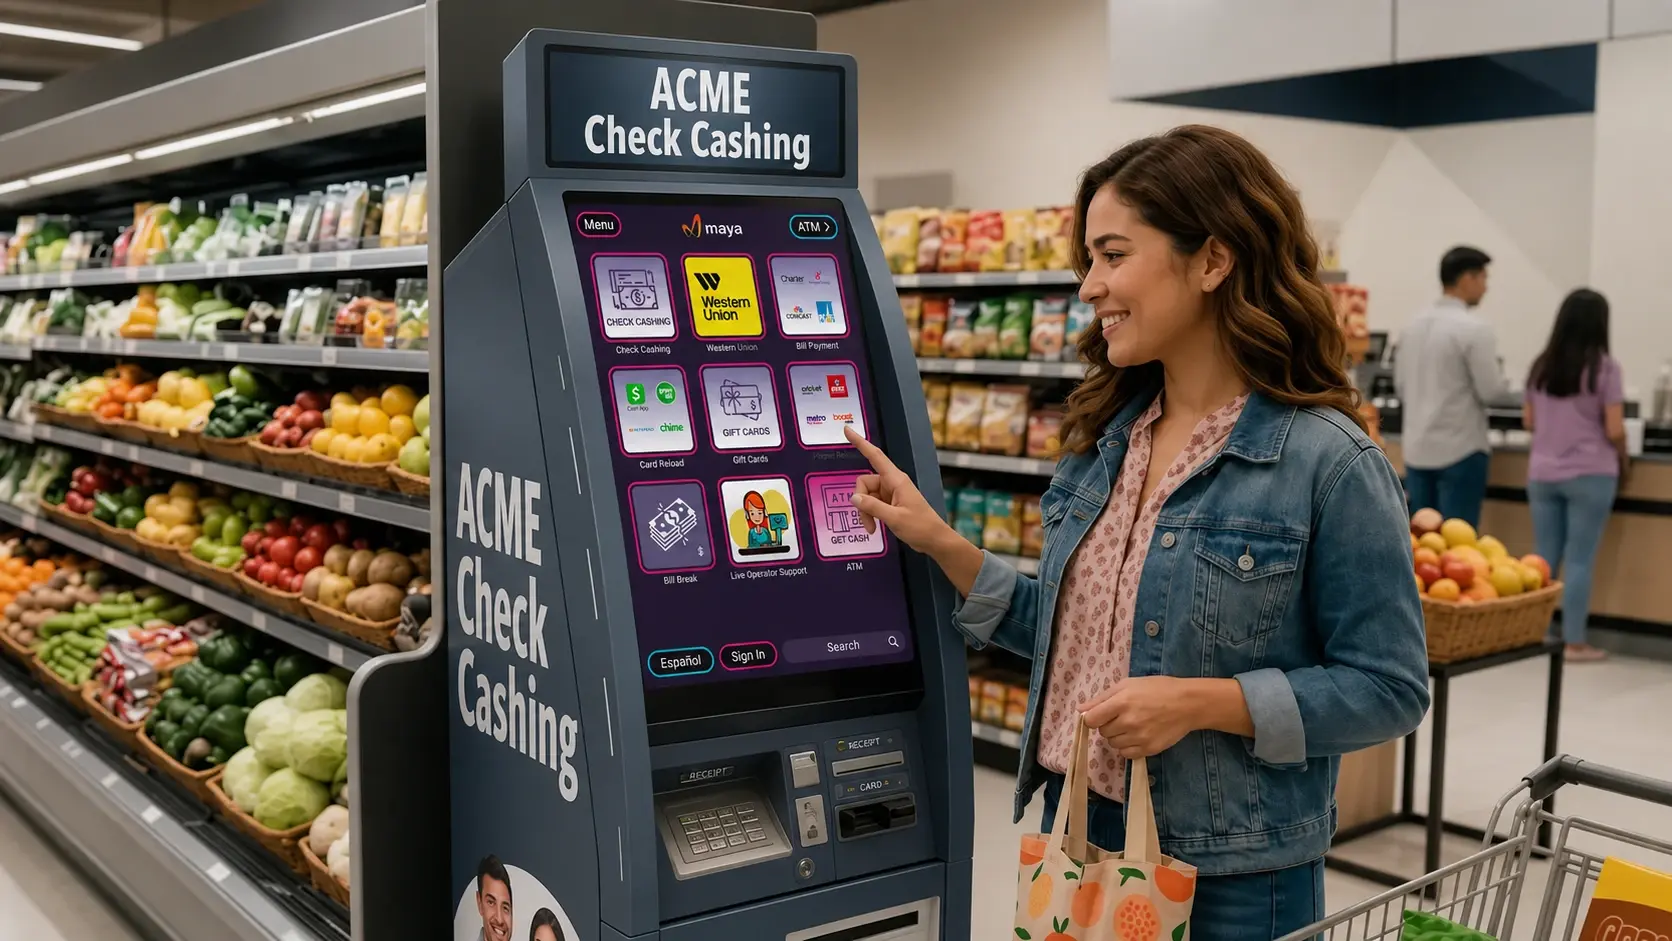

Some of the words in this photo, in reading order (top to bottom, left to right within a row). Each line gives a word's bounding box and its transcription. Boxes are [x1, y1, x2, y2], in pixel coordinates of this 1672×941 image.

[650, 66, 751, 114] ACME
[584, 114, 682, 157] Check
[690, 120, 811, 170] Cashing
[584, 218, 614, 230] Menu
[798, 222, 820, 232] ATM
[705, 224, 743, 238] maya
[701, 296, 751, 308] Western
[703, 309, 738, 320] Union
[606, 318, 634, 326] CHECK
[636, 317, 672, 326] CASHING
[616, 345, 639, 354] Check
[706, 343, 736, 352] Western
[737, 343, 758, 352] Union
[660, 421, 684, 432] chime
[723, 428, 740, 437] GIFT
[742, 427, 770, 436] CARDS
[640, 459, 658, 469] Card
[659, 458, 684, 468] Reload
[733, 455, 747, 464] Gift
[748, 454, 768, 463] Cards
[456, 462, 542, 566] ACME
[831, 535, 846, 544] GET
[849, 534, 870, 543] CASH
[846, 562, 863, 571] ATM
[664, 576, 675, 585] Bill
[677, 574, 698, 583] Break
[730, 571, 746, 580] Live
[747, 569, 778, 579] Operator
[779, 567, 808, 577] Support
[456, 554, 549, 669] Check
[827, 640, 860, 653] Search
[660, 654, 701, 670] Español
[731, 651, 754, 665] Sign
[756, 649, 766, 660] In
[457, 647, 578, 802] Cashing
[860, 780, 882, 792] CARD
